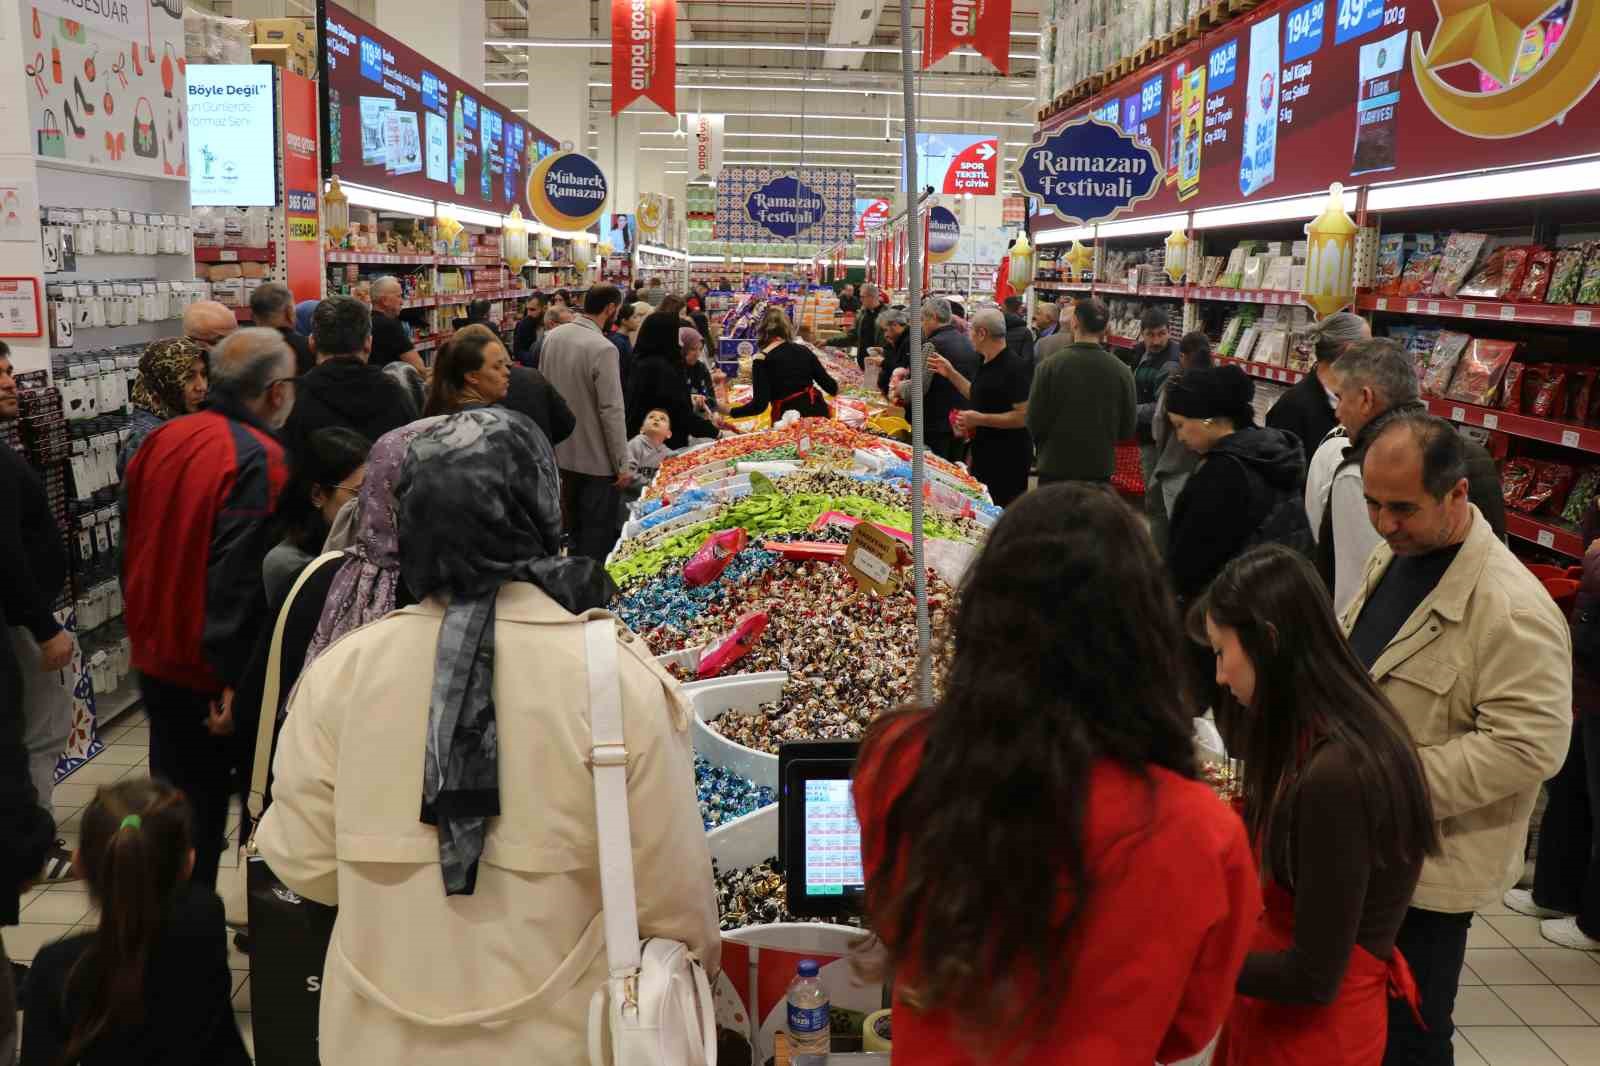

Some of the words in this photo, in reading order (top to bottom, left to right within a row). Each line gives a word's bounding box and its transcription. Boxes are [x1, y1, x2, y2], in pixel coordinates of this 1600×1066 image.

[632, 0, 650, 41] gros
[632, 44, 649, 90] anpa
[188, 84, 224, 97] Böyle
[960, 161, 985, 170] SPOR
[1033, 150, 1146, 175] Ramazan
[548, 170, 604, 190] Mübarek
[1039, 175, 1132, 198] Festivali
[547, 183, 605, 200] Ramazan
[288, 194, 300, 209] 365
[753, 193, 821, 209] Ramazan
[757, 209, 813, 223] Festivali
